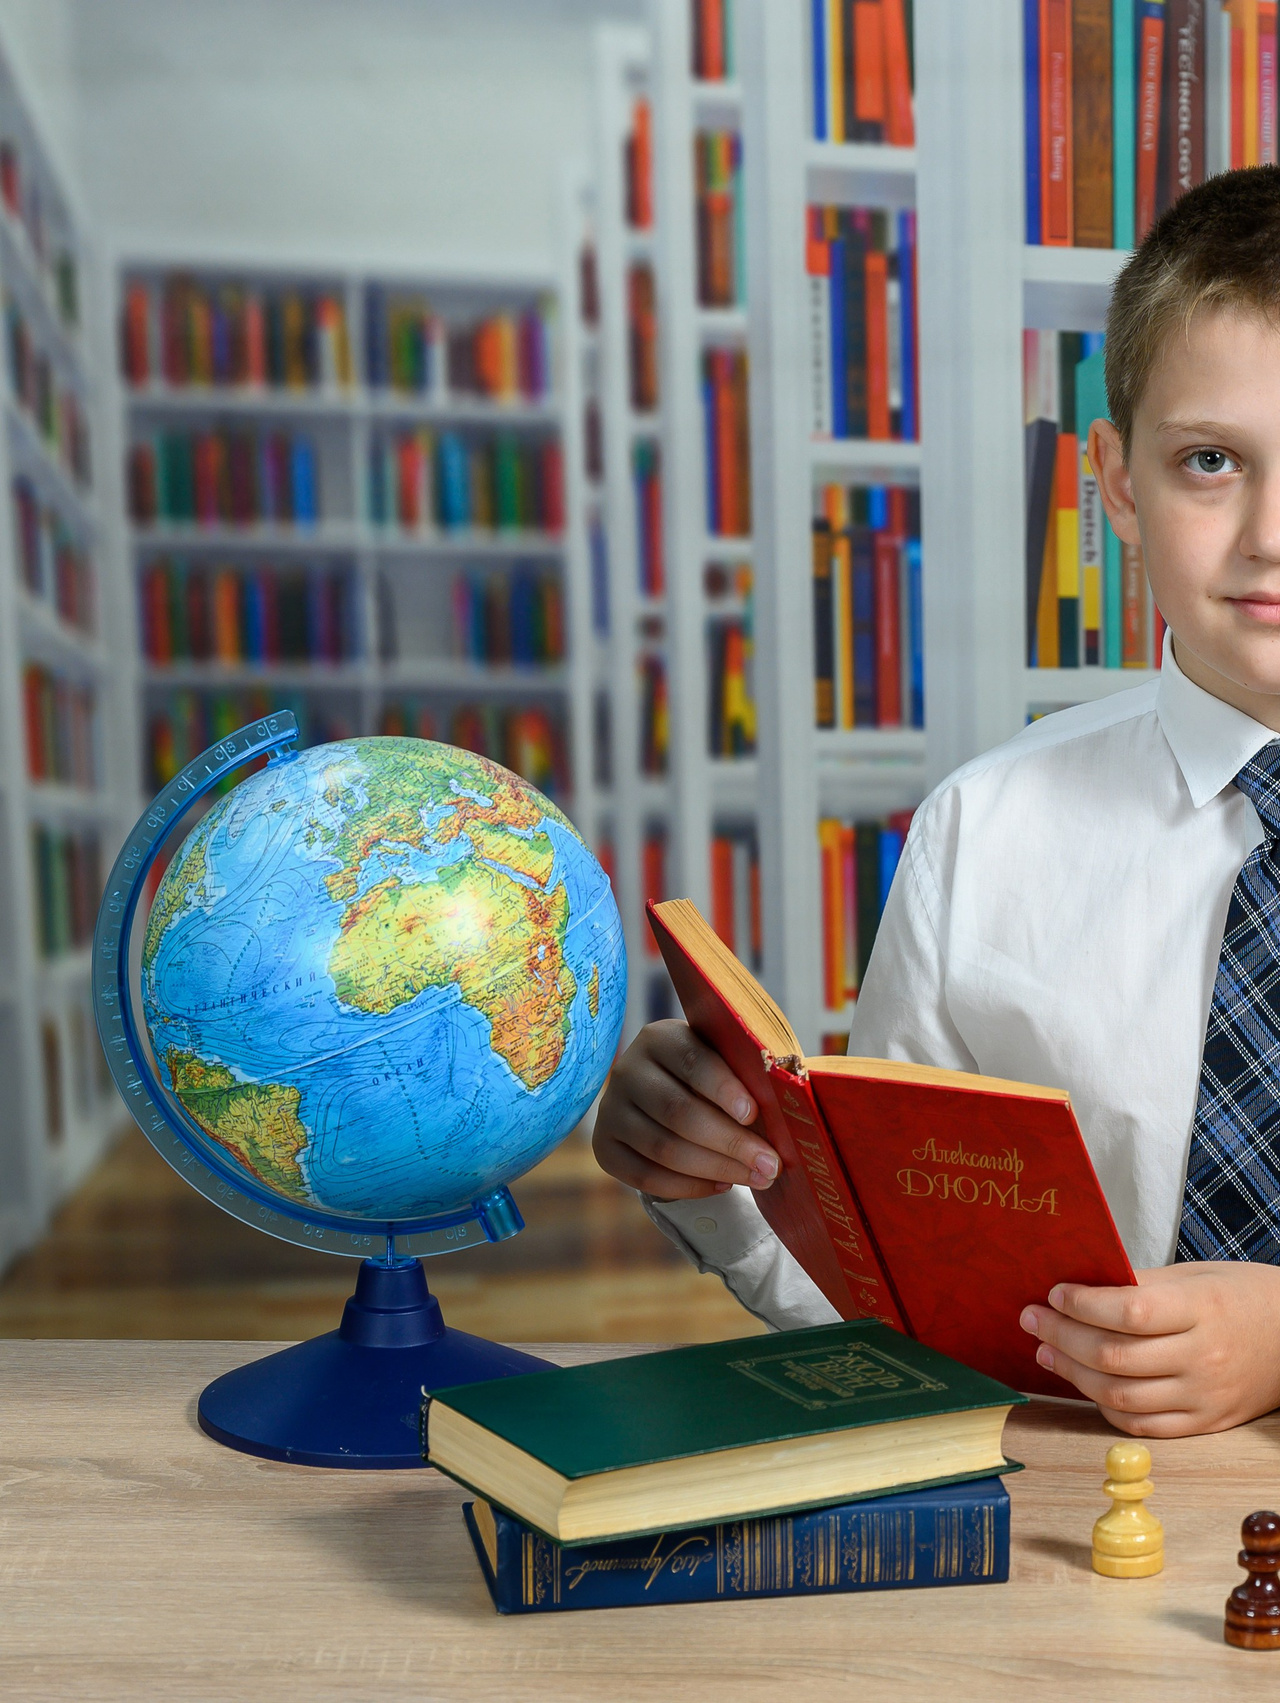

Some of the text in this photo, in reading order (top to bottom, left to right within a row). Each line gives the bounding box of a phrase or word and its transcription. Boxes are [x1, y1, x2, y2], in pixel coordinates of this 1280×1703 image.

[1083, 479, 1098, 563] Deutsch
[371, 1057, 425, 1086] ОКЕАН
[912, 1137, 1025, 1182] Александр
[896, 1168, 1062, 1217] ДЮМА
[809, 1361, 876, 1389] ВЕРН
[827, 1352, 904, 1389] ЖЮЛЬ
